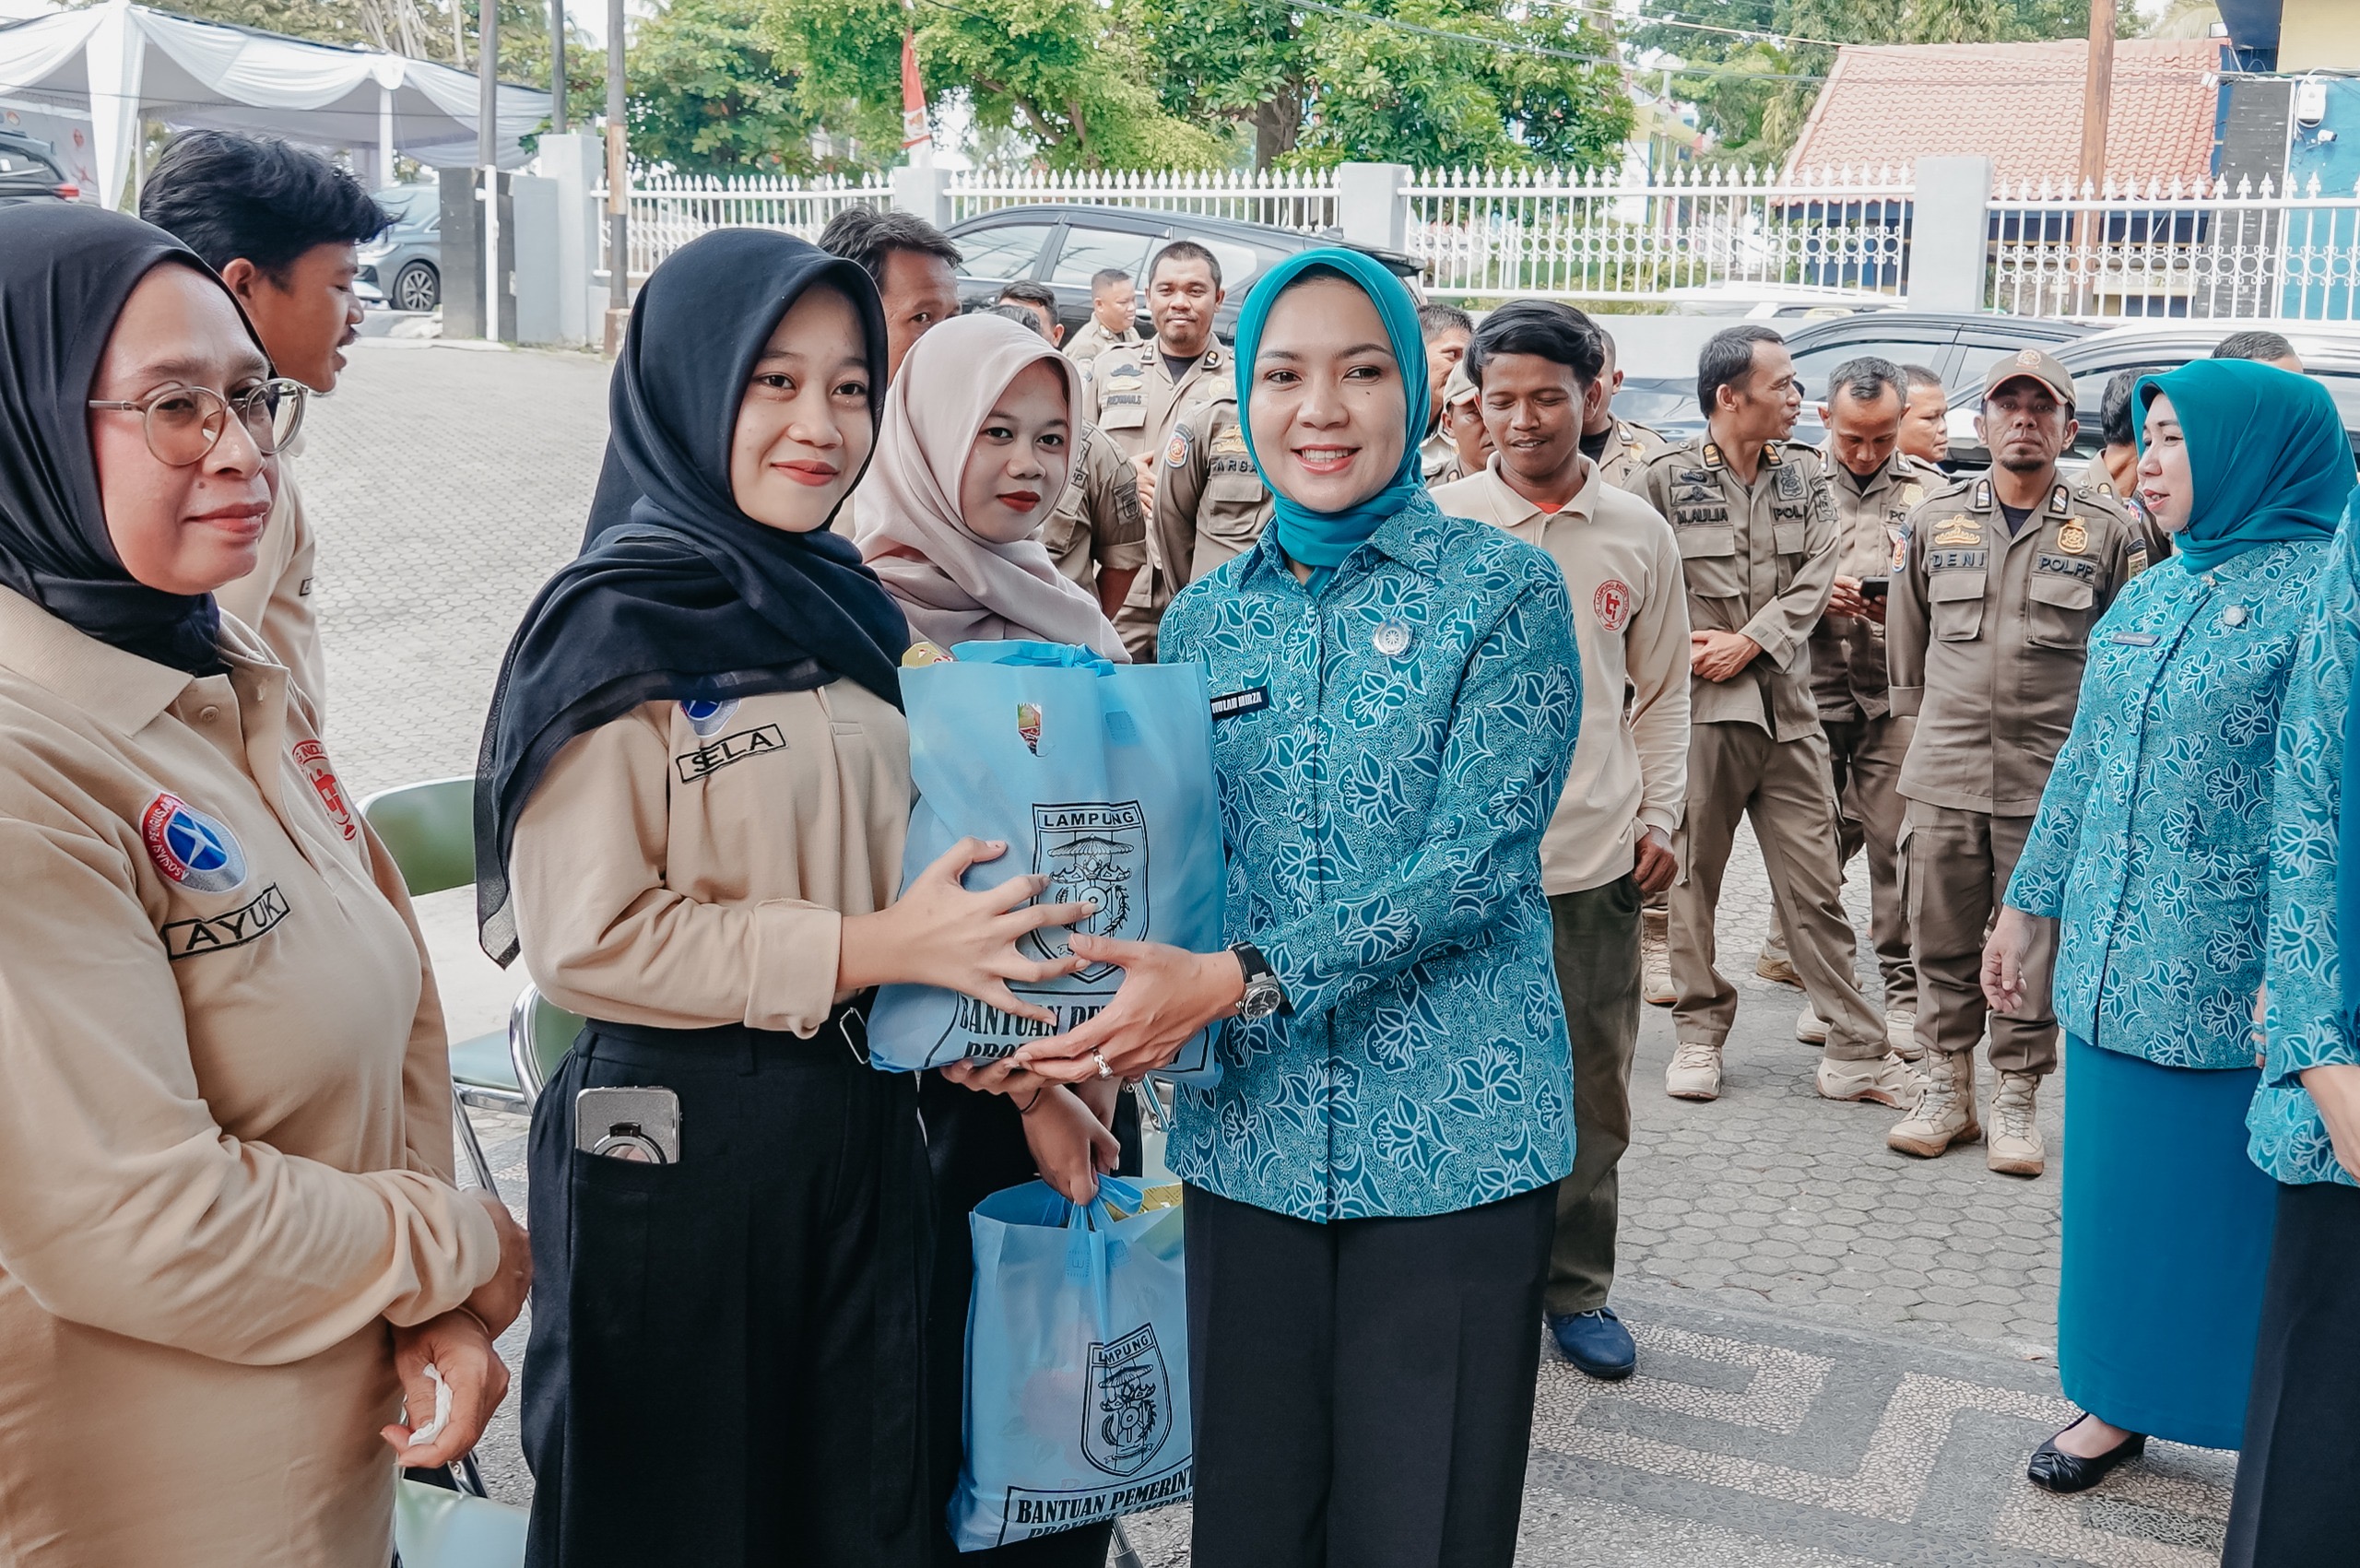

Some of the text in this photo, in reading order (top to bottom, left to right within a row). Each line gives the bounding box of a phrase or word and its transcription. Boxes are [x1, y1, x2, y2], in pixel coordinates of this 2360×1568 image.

[1932, 552, 1985, 568] DENI
[1211, 691, 1263, 713] WULAN MIRZA
[692, 732, 773, 772] SELA
[1044, 811, 1135, 827] LAMPUNG
[185, 891, 281, 951] AYUK
[1015, 1493, 1107, 1525] BANTUAN
